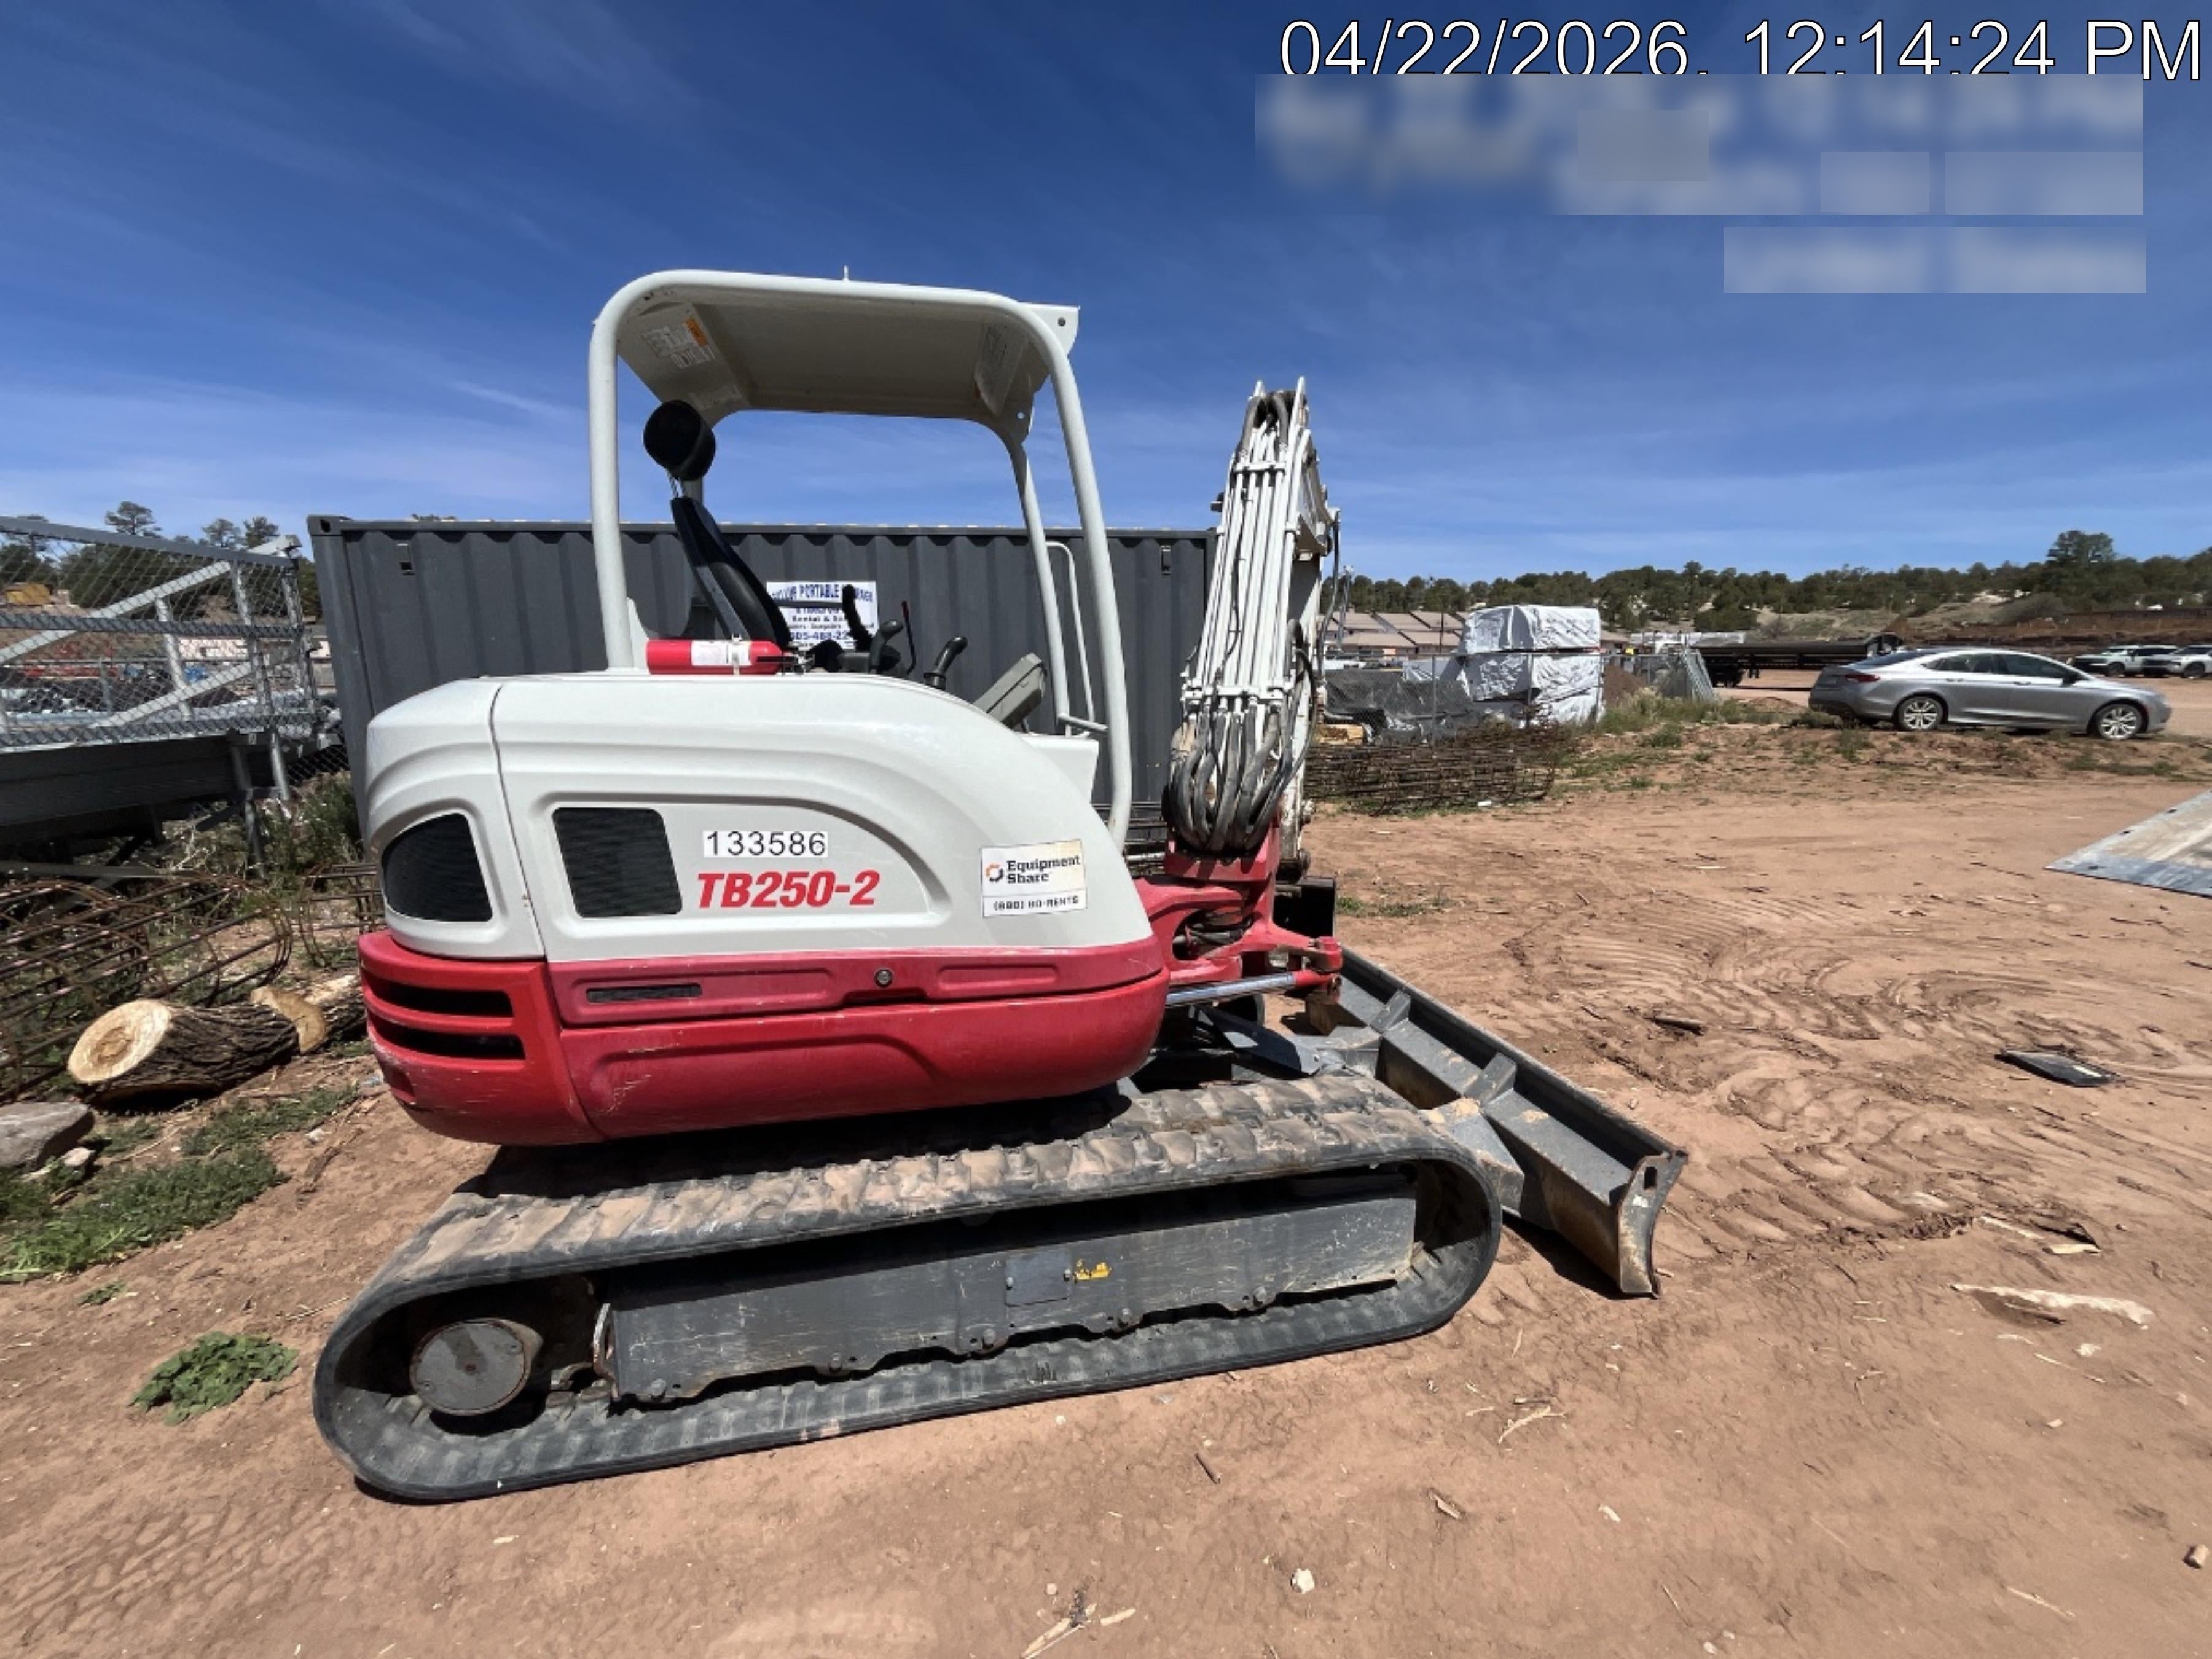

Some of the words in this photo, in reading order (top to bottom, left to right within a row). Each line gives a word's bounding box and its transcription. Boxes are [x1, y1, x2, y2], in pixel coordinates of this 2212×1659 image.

[800, 584, 840, 598] PORTABLE
[707, 830, 826, 856] 133586
[1006, 855, 1080, 873] Equipment
[1007, 873, 1049, 884] Share
[697, 870, 880, 908] TB250-2
